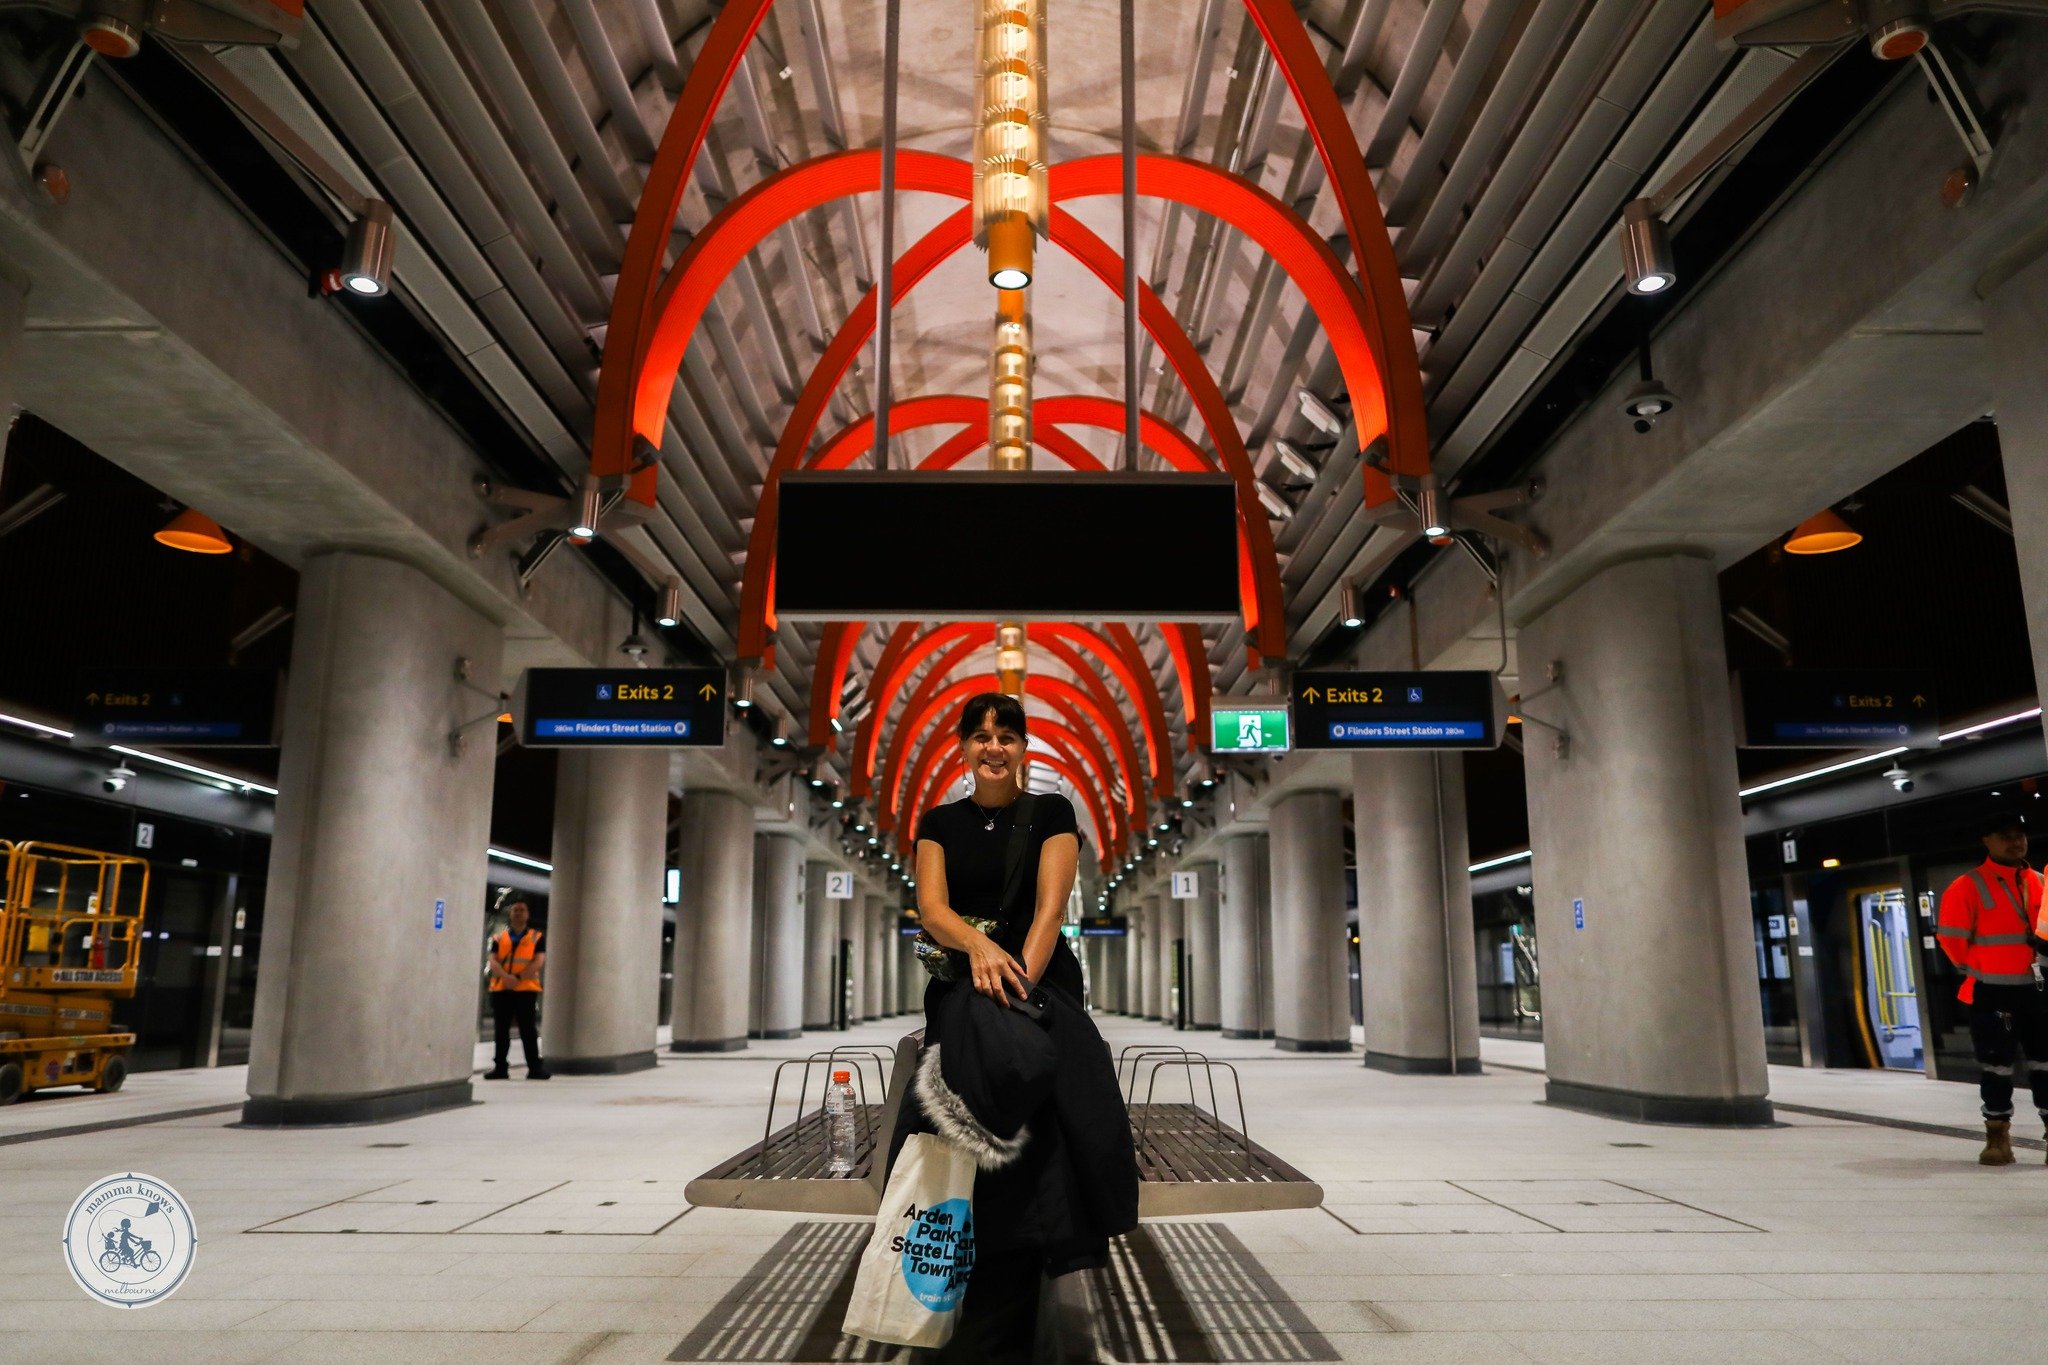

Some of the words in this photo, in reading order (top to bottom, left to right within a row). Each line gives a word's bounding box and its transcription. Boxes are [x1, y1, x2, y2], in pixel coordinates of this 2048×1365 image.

[105, 693, 138, 706] Exits
[141, 693, 150, 706] 2
[618, 684, 659, 700] Exits
[663, 684, 674, 700] 2
[1327, 688, 1369, 703] Exits
[1372, 687, 1383, 703] 2
[1849, 695, 1882, 708] Exits
[1885, 695, 1894, 708] 2
[576, 723, 610, 733] Flinders
[612, 723, 639, 733] Street
[641, 723, 671, 733] Station
[1347, 726, 1382, 736] Flinders
[1384, 726, 1410, 736] Street
[1412, 726, 1443, 735] Station
[141, 827, 150, 845] 2
[832, 876, 842, 893] 2
[1184, 877, 1191, 893] 1
[75, 972, 94, 982] STAR
[903, 1203, 953, 1226] Arden
[890, 1236, 942, 1259] State
[910, 1256, 954, 1278] Town
[920, 1292, 942, 1303] train
